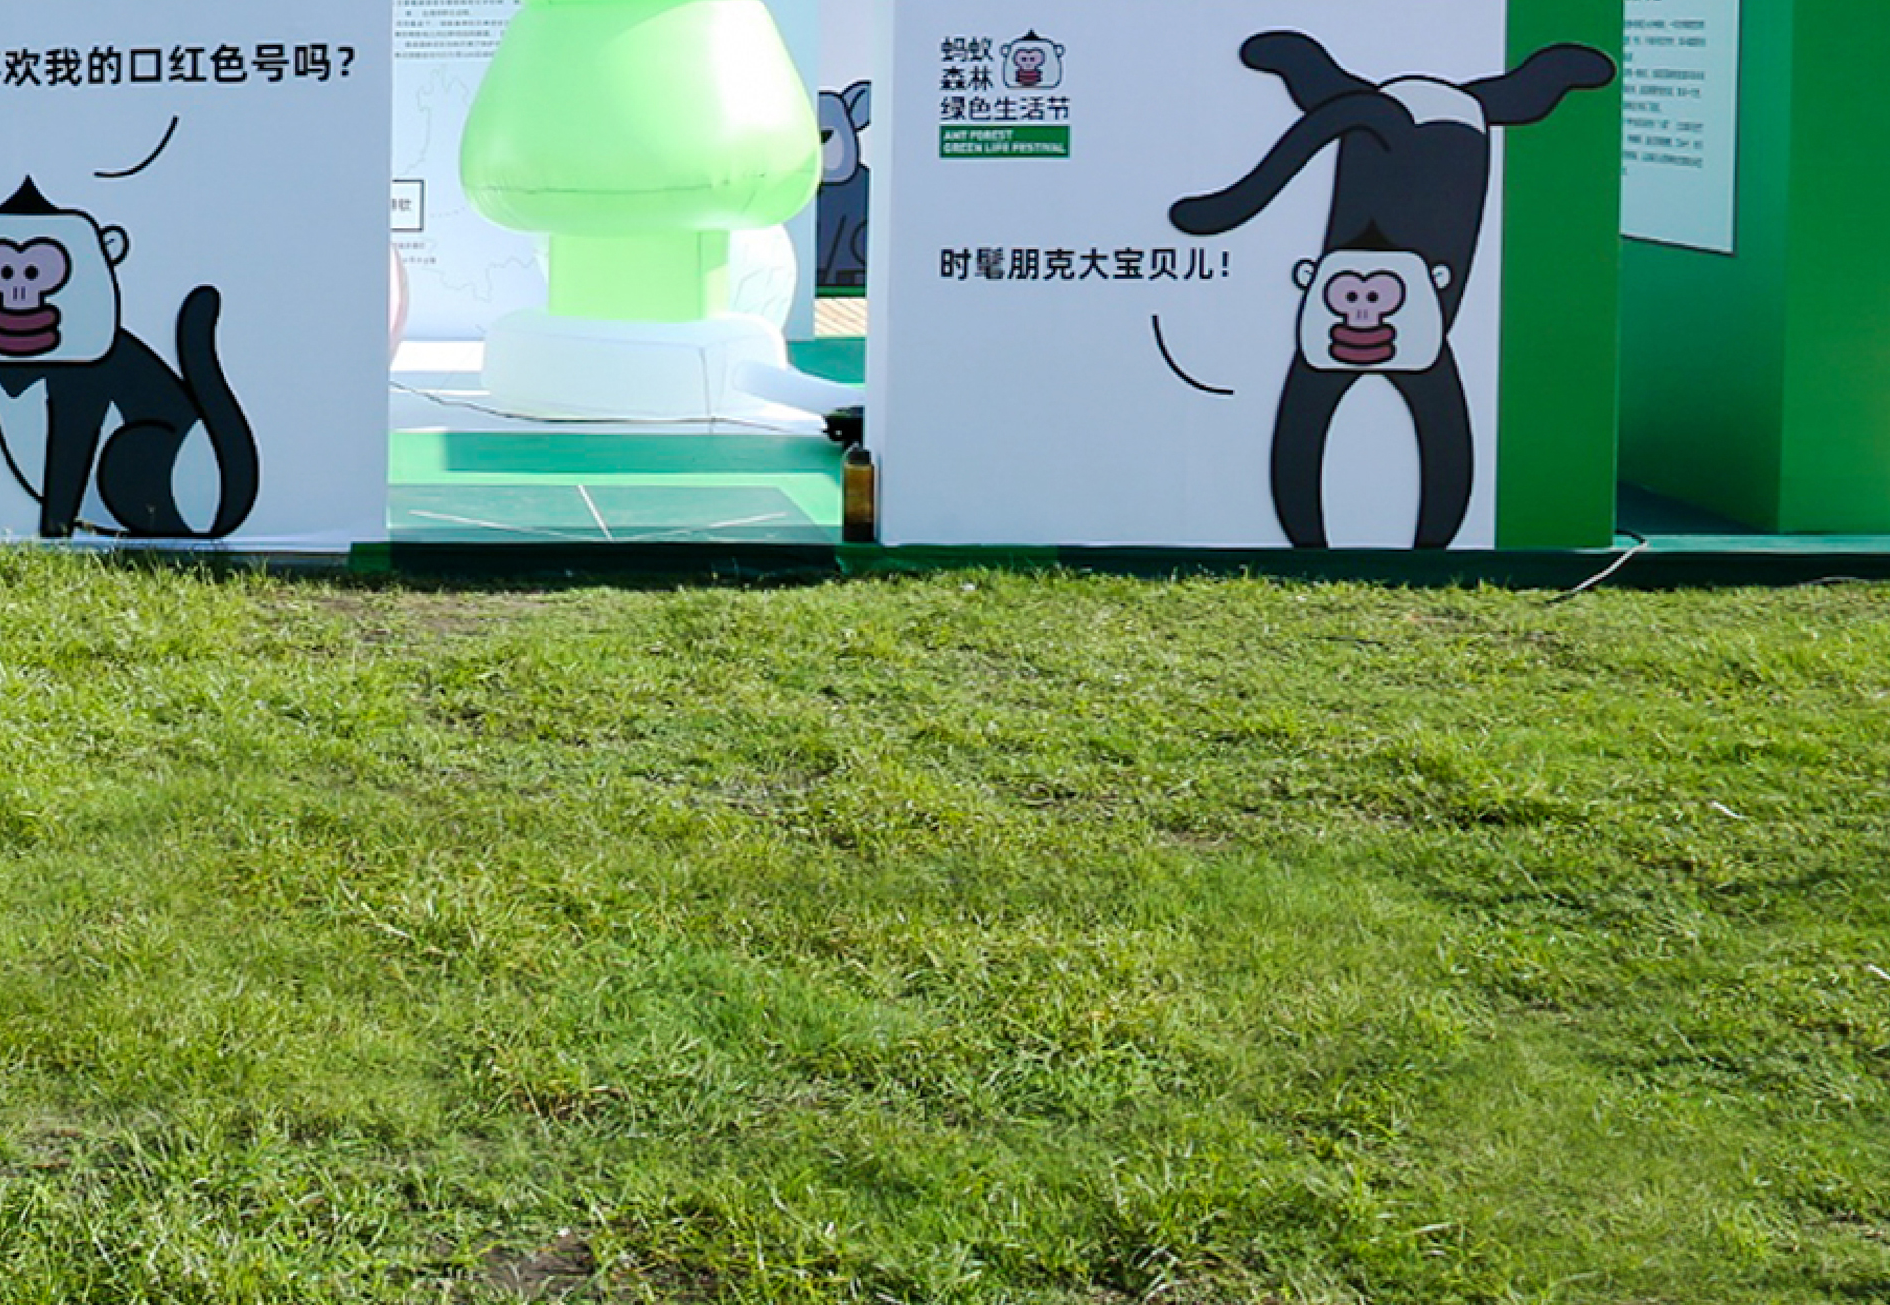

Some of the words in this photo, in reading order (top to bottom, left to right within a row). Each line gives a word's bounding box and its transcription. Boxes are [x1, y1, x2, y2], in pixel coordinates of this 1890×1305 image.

[940, 36, 994, 62] 蚂蚁
[939, 66, 994, 91] 森林
[940, 96, 1071, 120] 绿色生活节
[943, 129, 968, 140] ANT
[939, 247, 1230, 281] 时髦朋克大宝贝儿！
